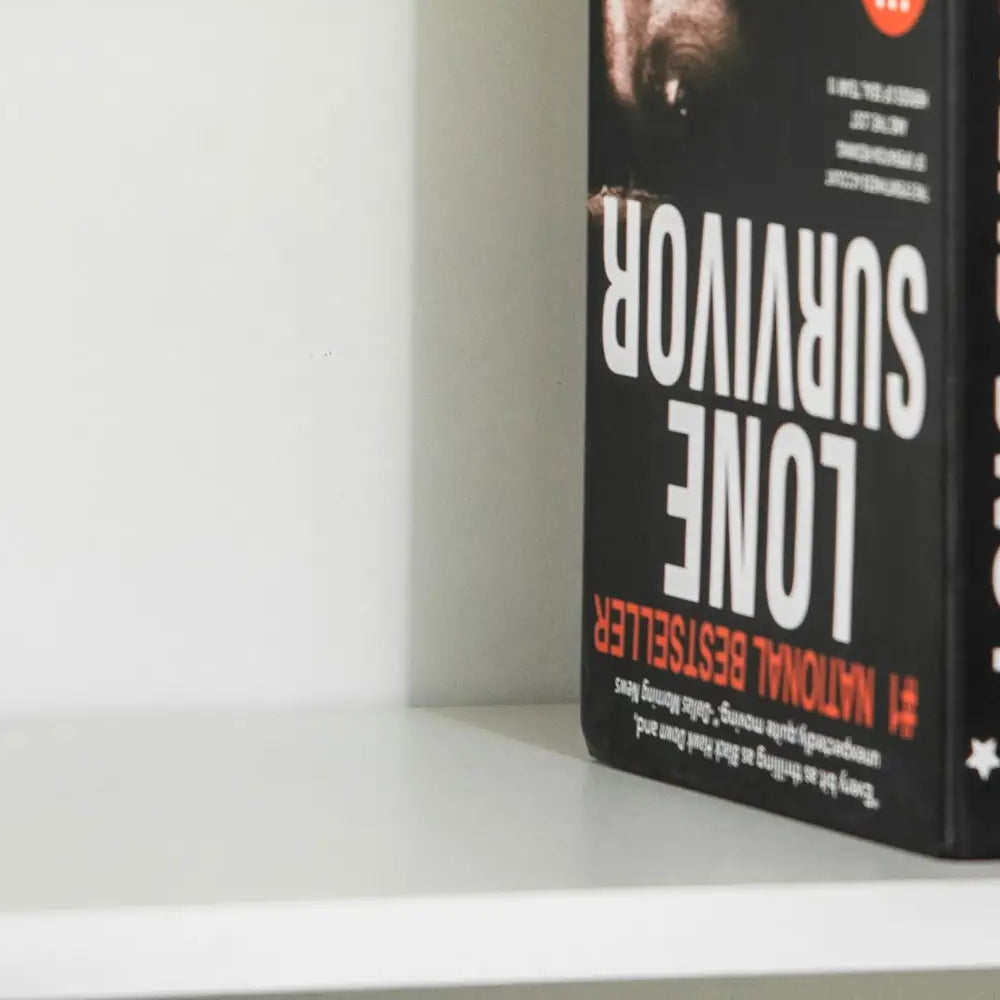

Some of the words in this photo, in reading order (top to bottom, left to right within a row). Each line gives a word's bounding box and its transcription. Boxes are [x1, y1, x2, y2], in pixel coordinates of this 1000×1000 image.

[601, 195, 929, 440] SURVIVOR
[662, 398, 858, 645] LONE
[593, 593, 748, 692] BESTSELLER
[614, 676, 641, 705] News
[640, 678, 681, 716] Morning
[752, 635, 875, 729] NATIONAL
[887, 671, 919, 740] #1
[633, 711, 659, 739] and,
[658, 722, 687, 752] Down
[765, 719, 798, 747] quite
[686, 730, 714, 759] Hawk
[713, 738, 741, 769] Black
[740, 744, 756, 766] as
[756, 744, 804, 787] thrilling
[803, 763, 819, 786] as
[819, 768, 839, 799] bit
